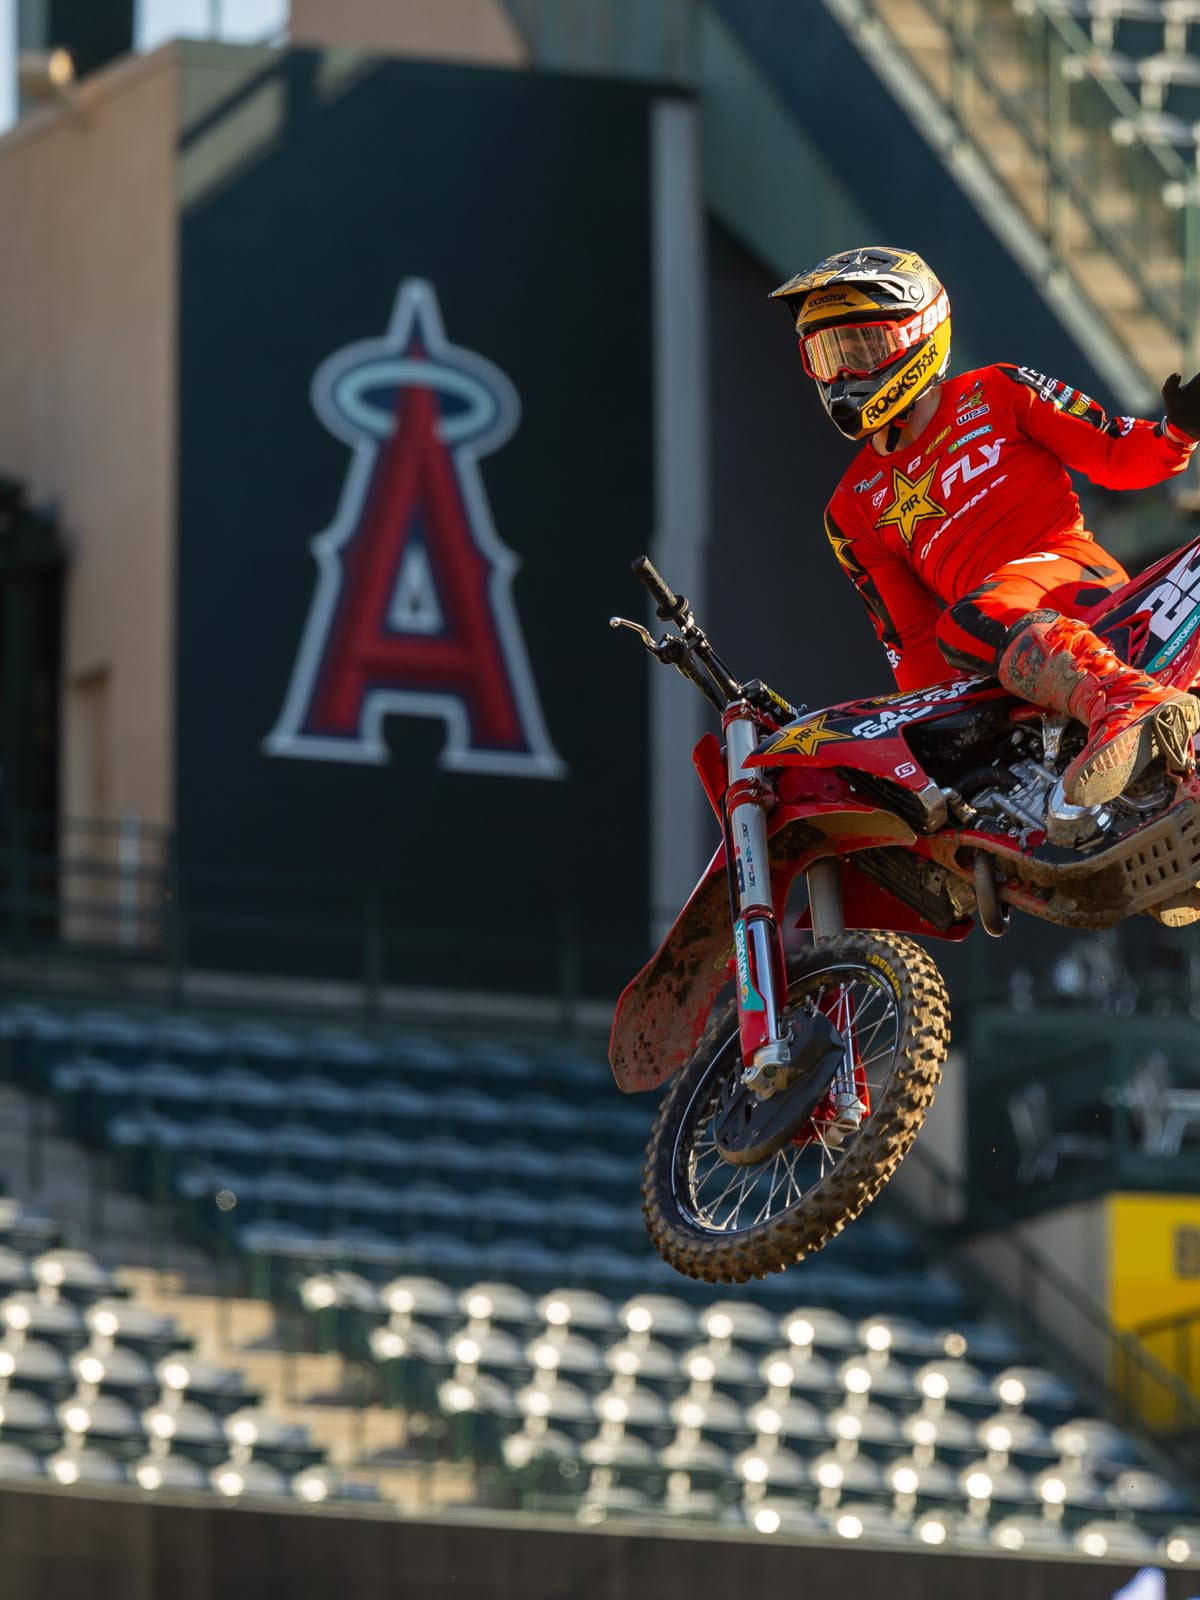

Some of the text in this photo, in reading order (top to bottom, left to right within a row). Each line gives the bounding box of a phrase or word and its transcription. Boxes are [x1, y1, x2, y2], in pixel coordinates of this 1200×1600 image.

[866, 343, 938, 425] ROCKSTAR
[957, 404, 989, 425] WPS
[957, 425, 992, 447] MOTOREX
[941, 438, 1006, 499] FLY
[1164, 614, 1200, 656] MOTOREX
[735, 922, 749, 986] MOTOREX
